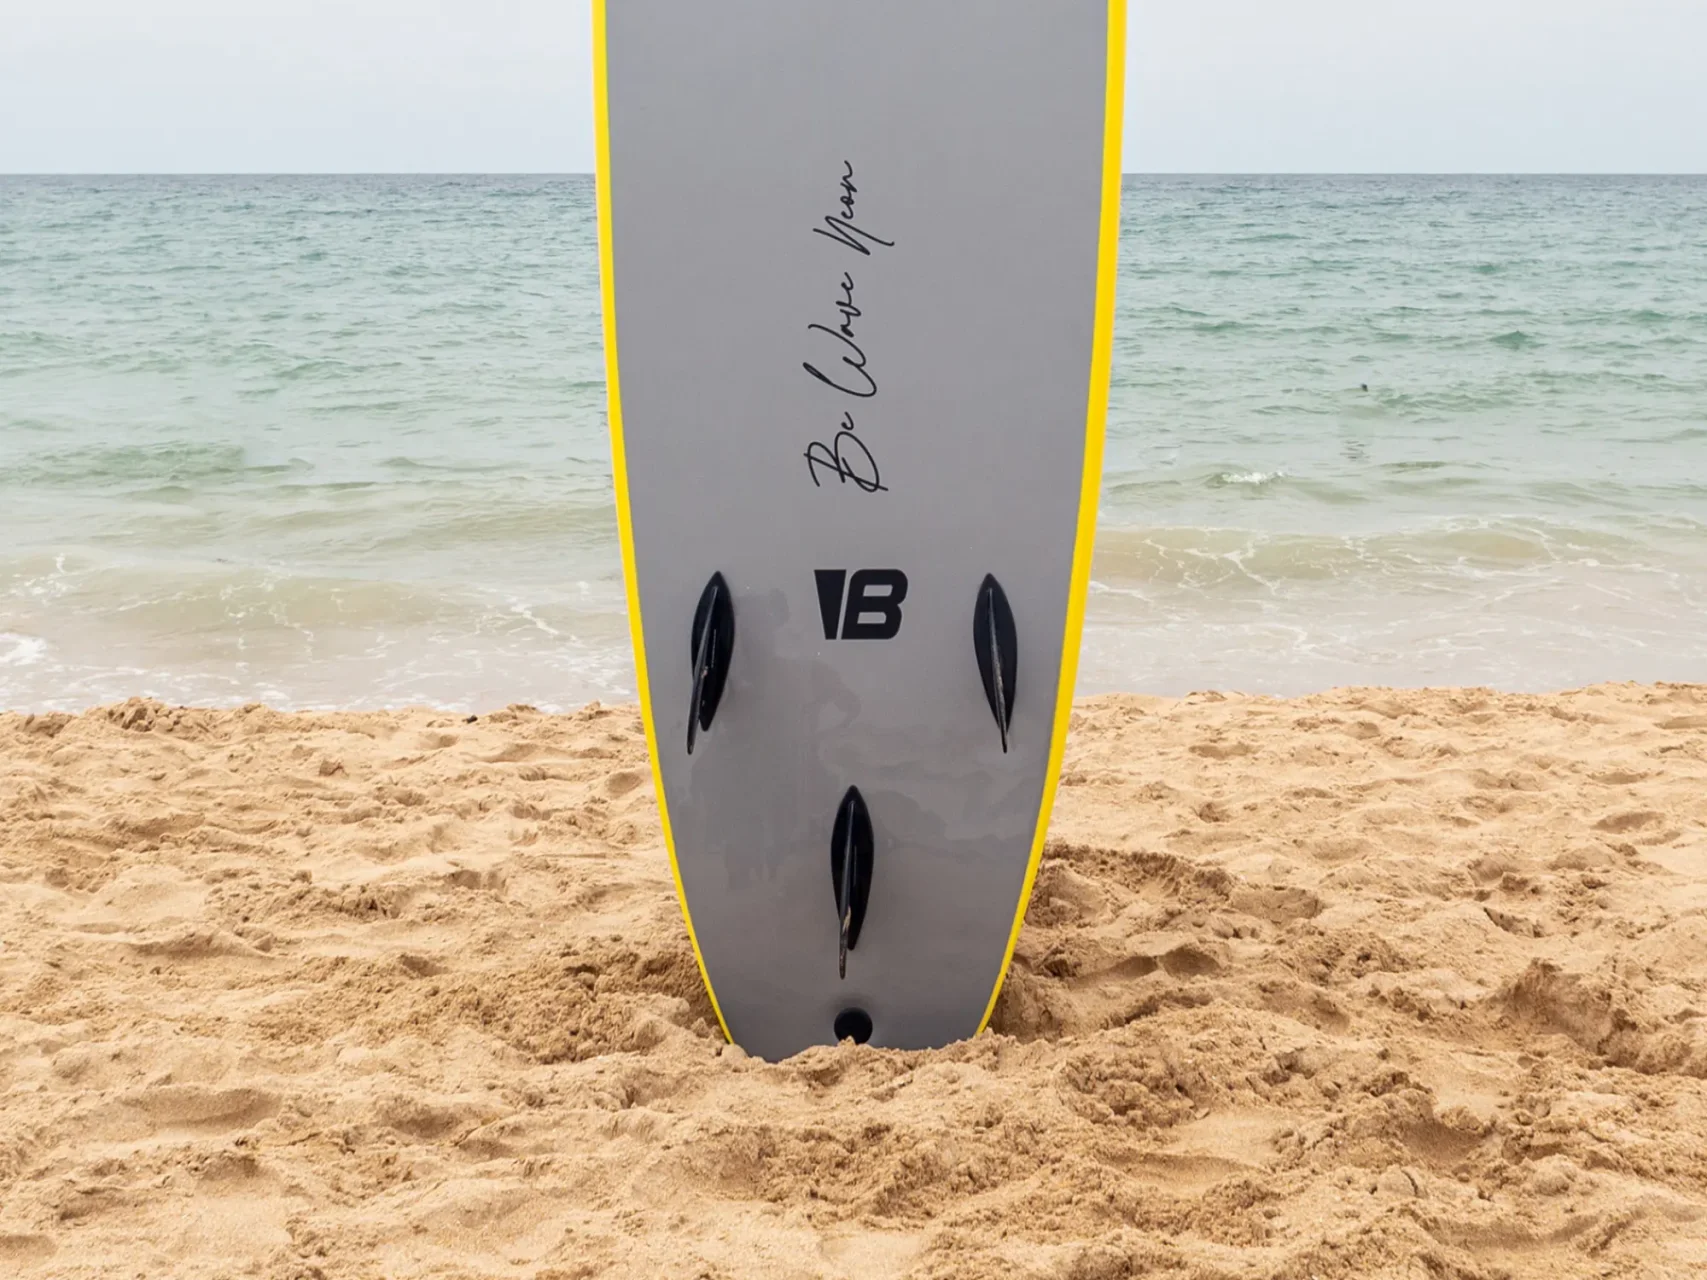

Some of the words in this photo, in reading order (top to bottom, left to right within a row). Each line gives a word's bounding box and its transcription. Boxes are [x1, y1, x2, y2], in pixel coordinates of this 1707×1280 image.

[812, 159, 895, 256] Neon
[802, 271, 878, 398] Wave
[803, 411, 889, 493] Be
